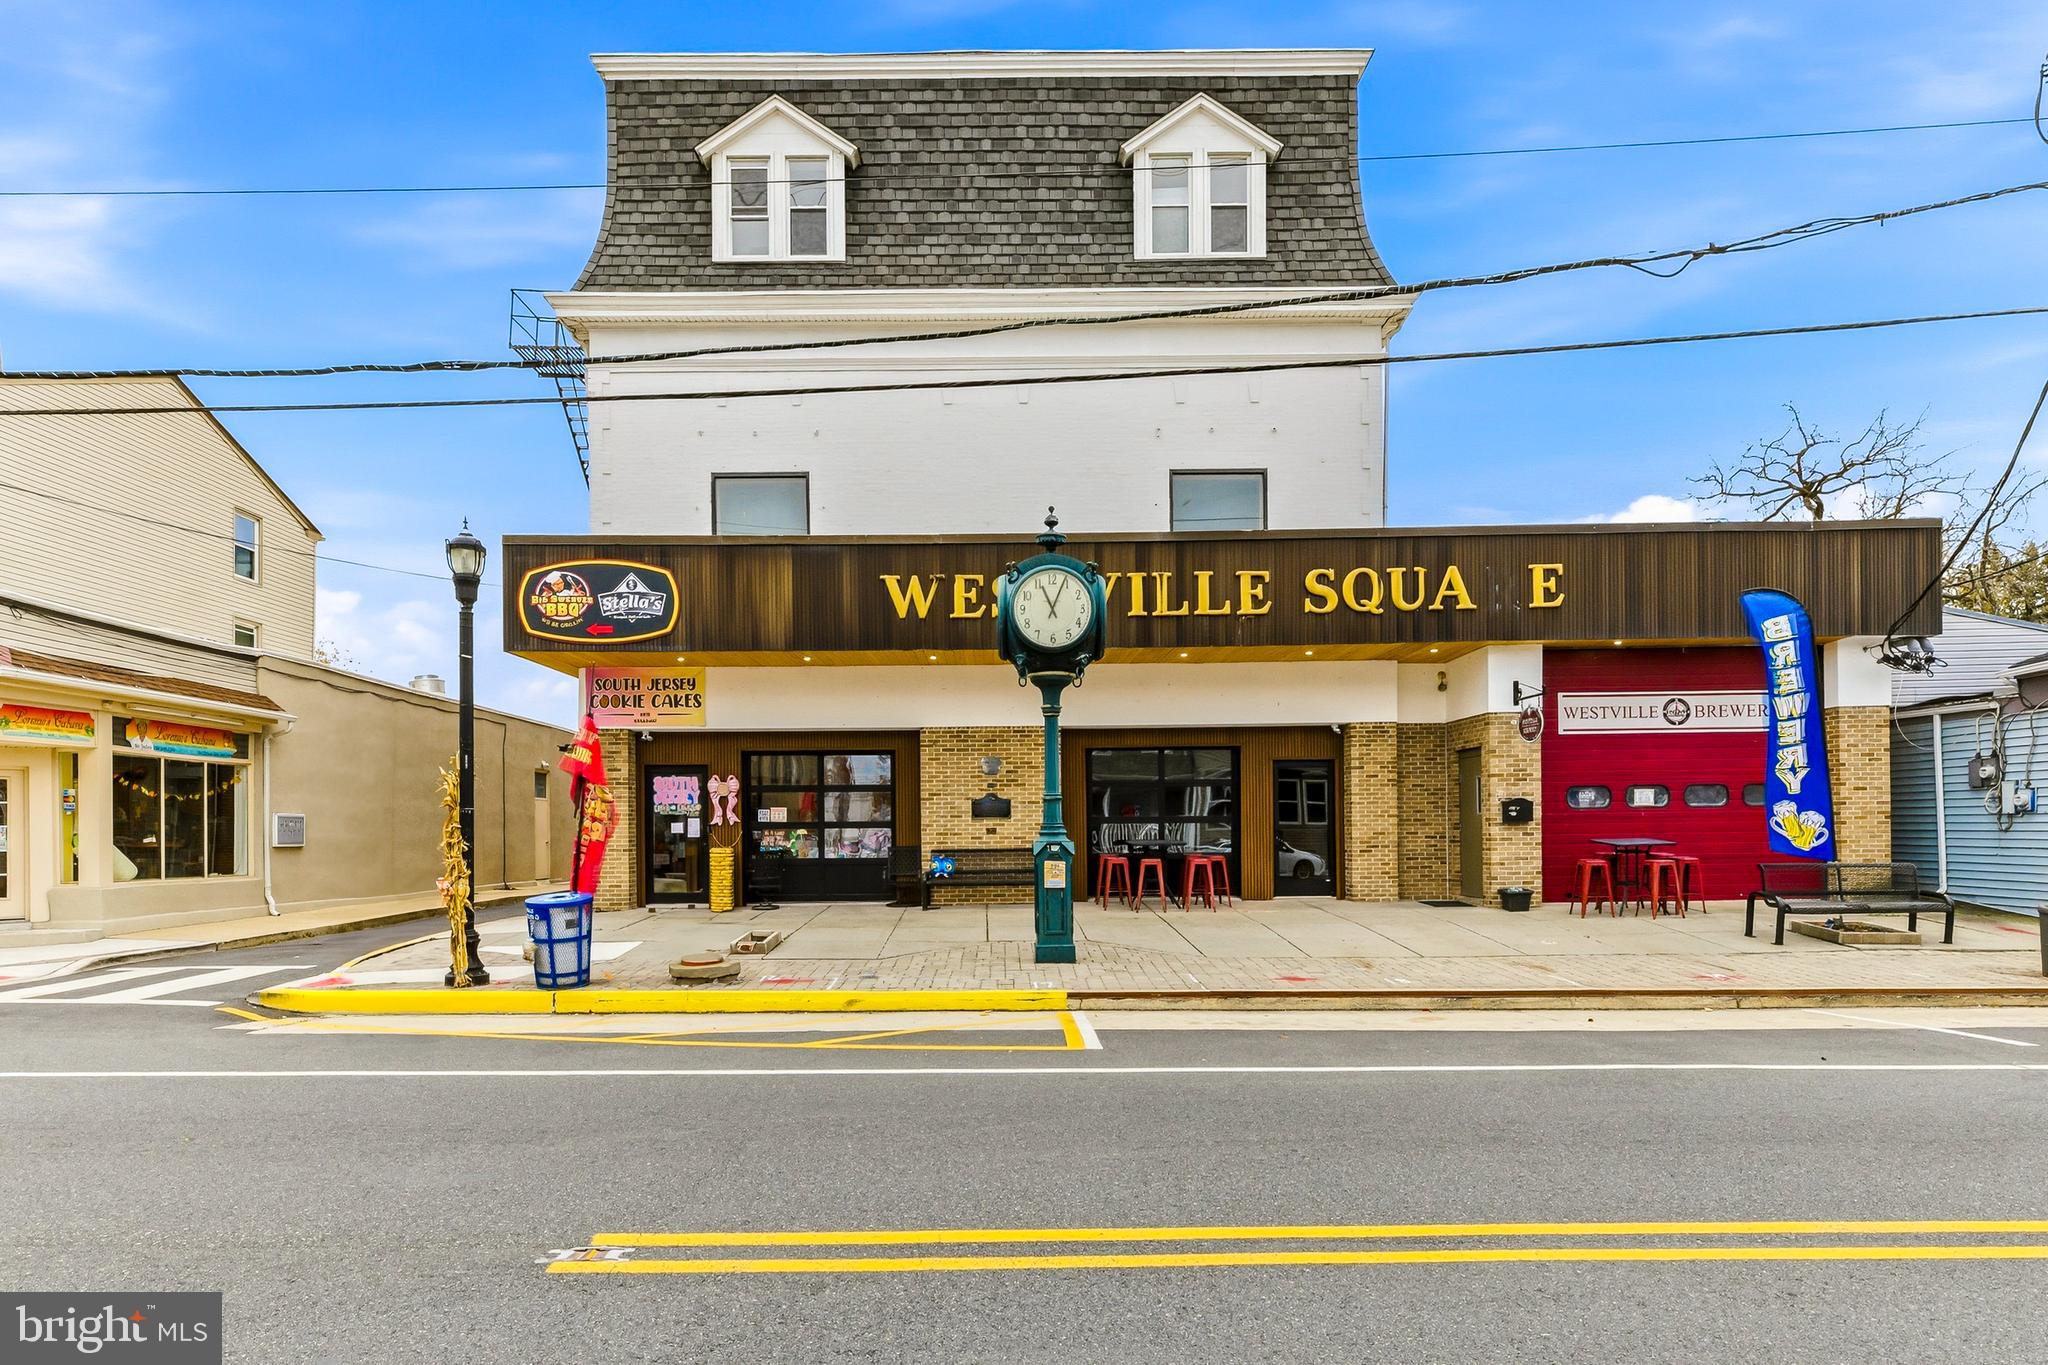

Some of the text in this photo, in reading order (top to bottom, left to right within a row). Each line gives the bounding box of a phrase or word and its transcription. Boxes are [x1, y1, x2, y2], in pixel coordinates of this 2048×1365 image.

[1034, 579, 1042, 590] 11
[1048, 574, 1057, 585] 12
[880, 570, 1272, 620] WEILLE
[1023, 591, 1032, 601] 10
[1075, 589, 1081, 601] 2
[602, 593, 663, 611] Stella's
[1019, 605, 1026, 615] 9
[1079, 604, 1086, 614] 3
[1024, 618, 1031, 629] 8
[1075, 617, 1081, 629] 4
[1034, 630, 1040, 640] 7
[1050, 633, 1057, 644] 6
[1065, 629, 1072, 641] 5
[594, 677, 696, 691] SOUTH JERSEY
[590, 693, 702, 708] COOKIE CAKES
[1563, 703, 1769, 719] WESTVILLE BREWER
